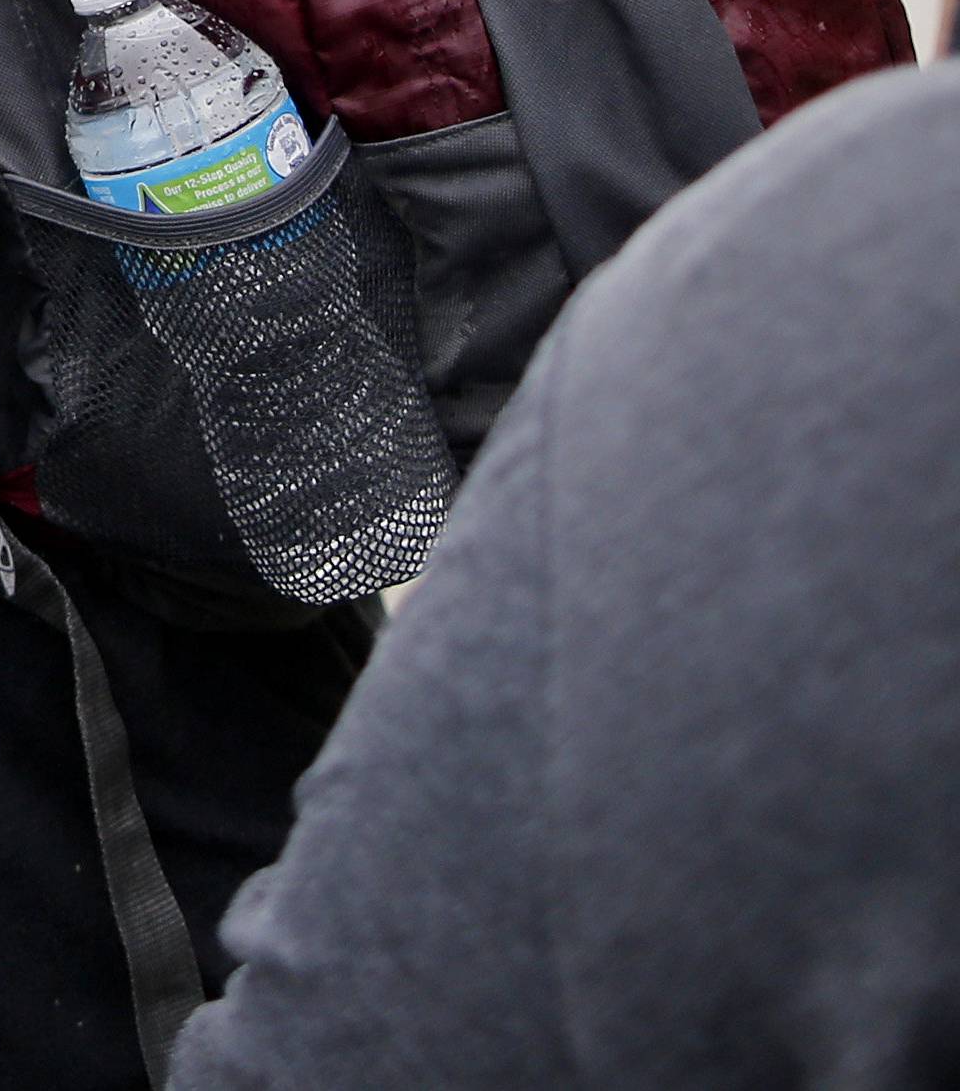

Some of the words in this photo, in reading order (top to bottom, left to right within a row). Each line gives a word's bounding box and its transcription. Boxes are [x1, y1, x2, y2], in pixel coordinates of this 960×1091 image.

[163, 185, 182, 197] Our
[184, 170, 223, 189] 12-Step
[224, 153, 257, 173] Quality
[194, 179, 236, 200] Process
[236, 174, 246, 184] is
[247, 165, 262, 178] our
[224, 193, 235, 203] to
[237, 177, 267, 198] deliver
